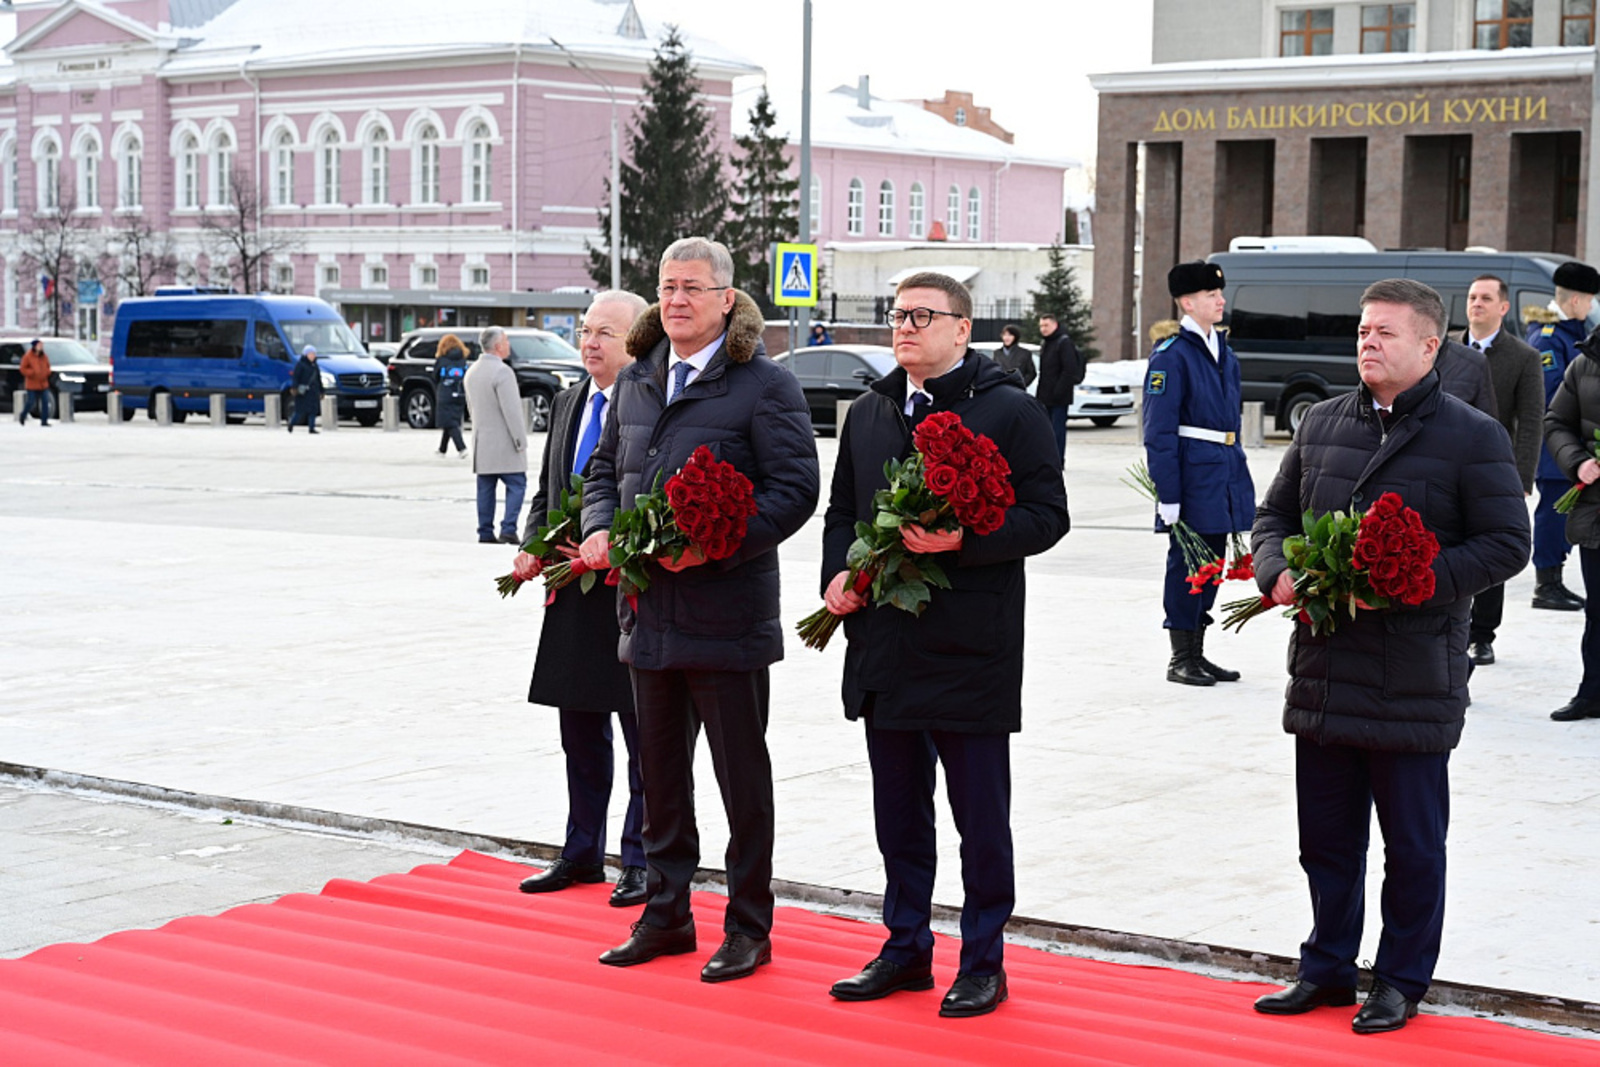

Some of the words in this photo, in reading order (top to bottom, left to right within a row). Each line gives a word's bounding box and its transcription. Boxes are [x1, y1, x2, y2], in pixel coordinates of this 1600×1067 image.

[1152, 107, 1216, 133] ДОМ
[1226, 93, 1430, 130] БАШКИРСКОЙ
[1443, 96, 1548, 123] КУХНИ
